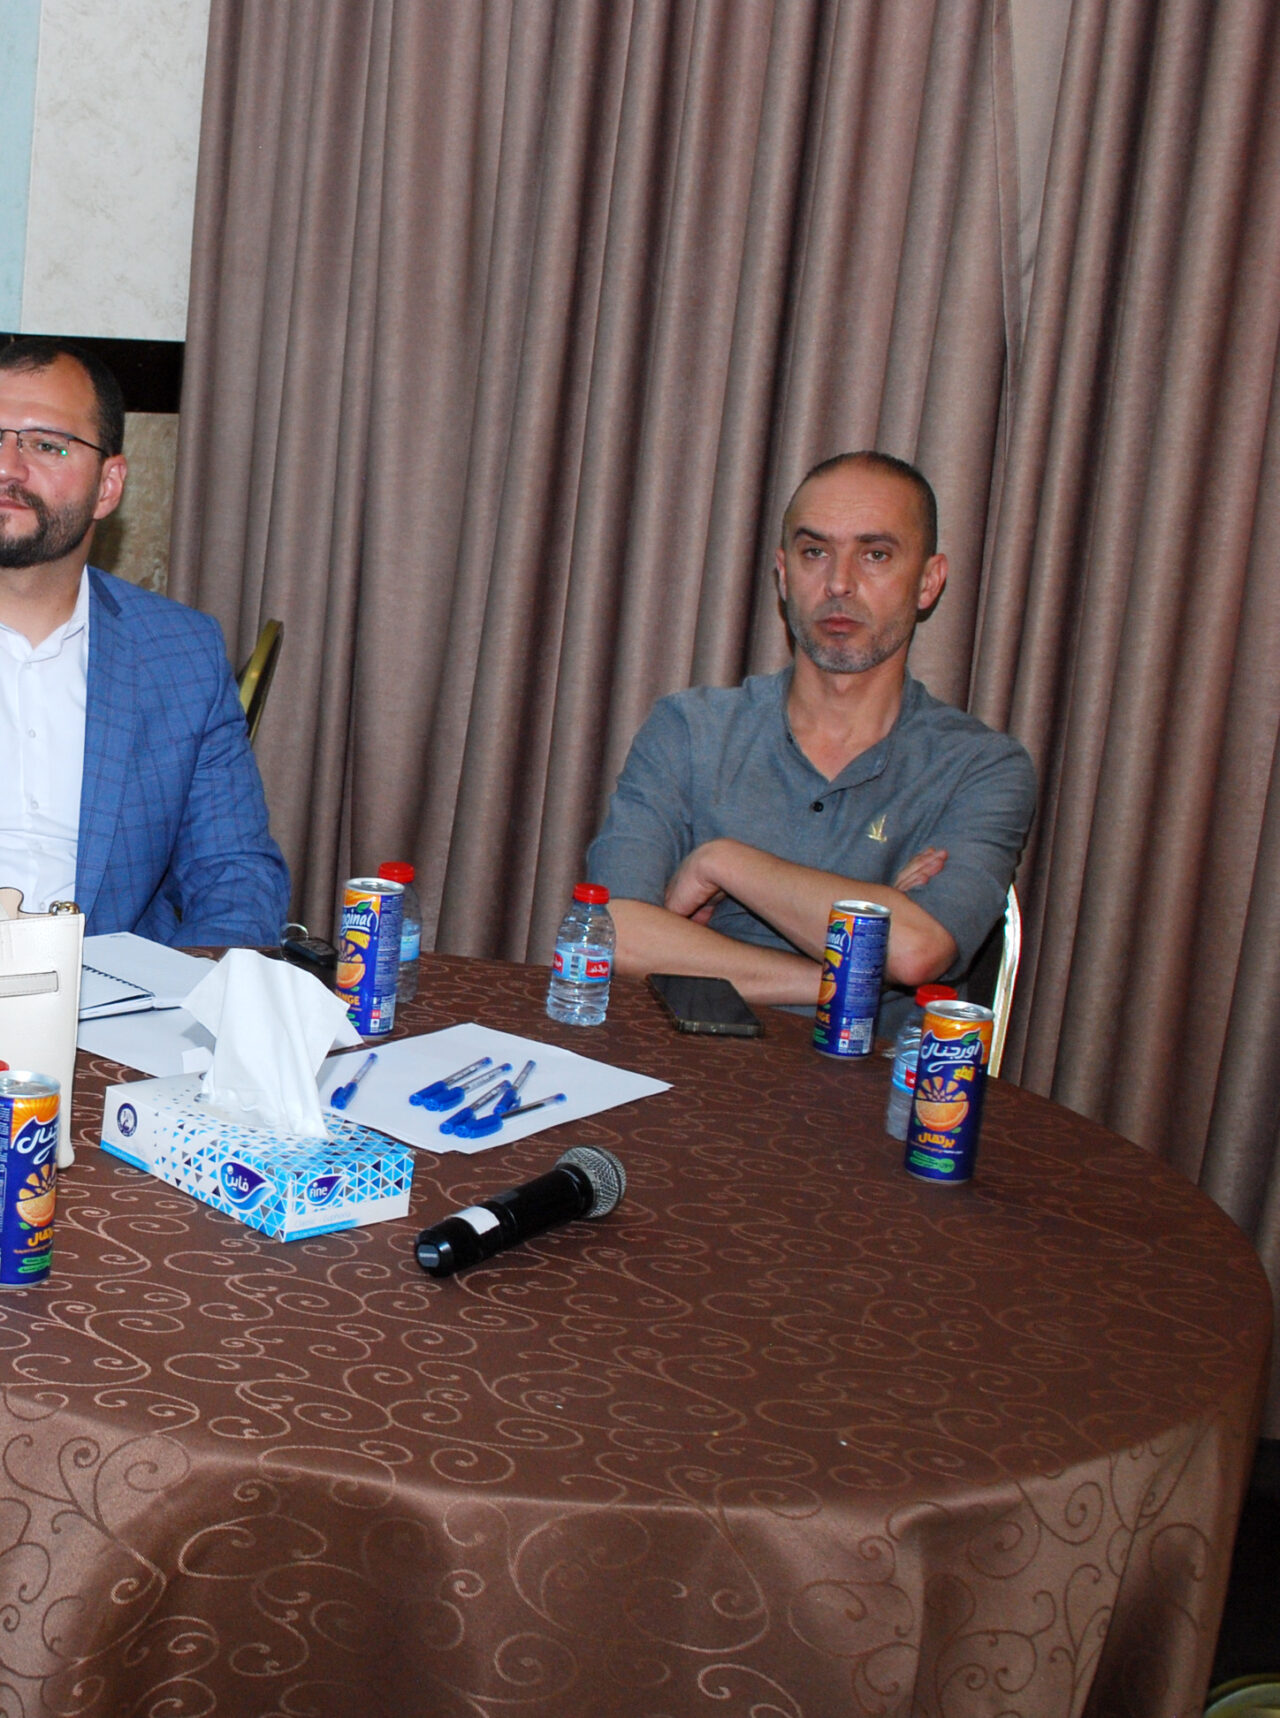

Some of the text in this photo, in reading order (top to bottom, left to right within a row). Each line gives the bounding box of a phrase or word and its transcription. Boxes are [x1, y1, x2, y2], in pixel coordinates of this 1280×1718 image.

[921, 1041, 980, 1060] اورجنال
[918, 1132, 956, 1149] برتقال
[224, 1164, 250, 1193] فاين
[309, 1181, 328, 1199] fine
